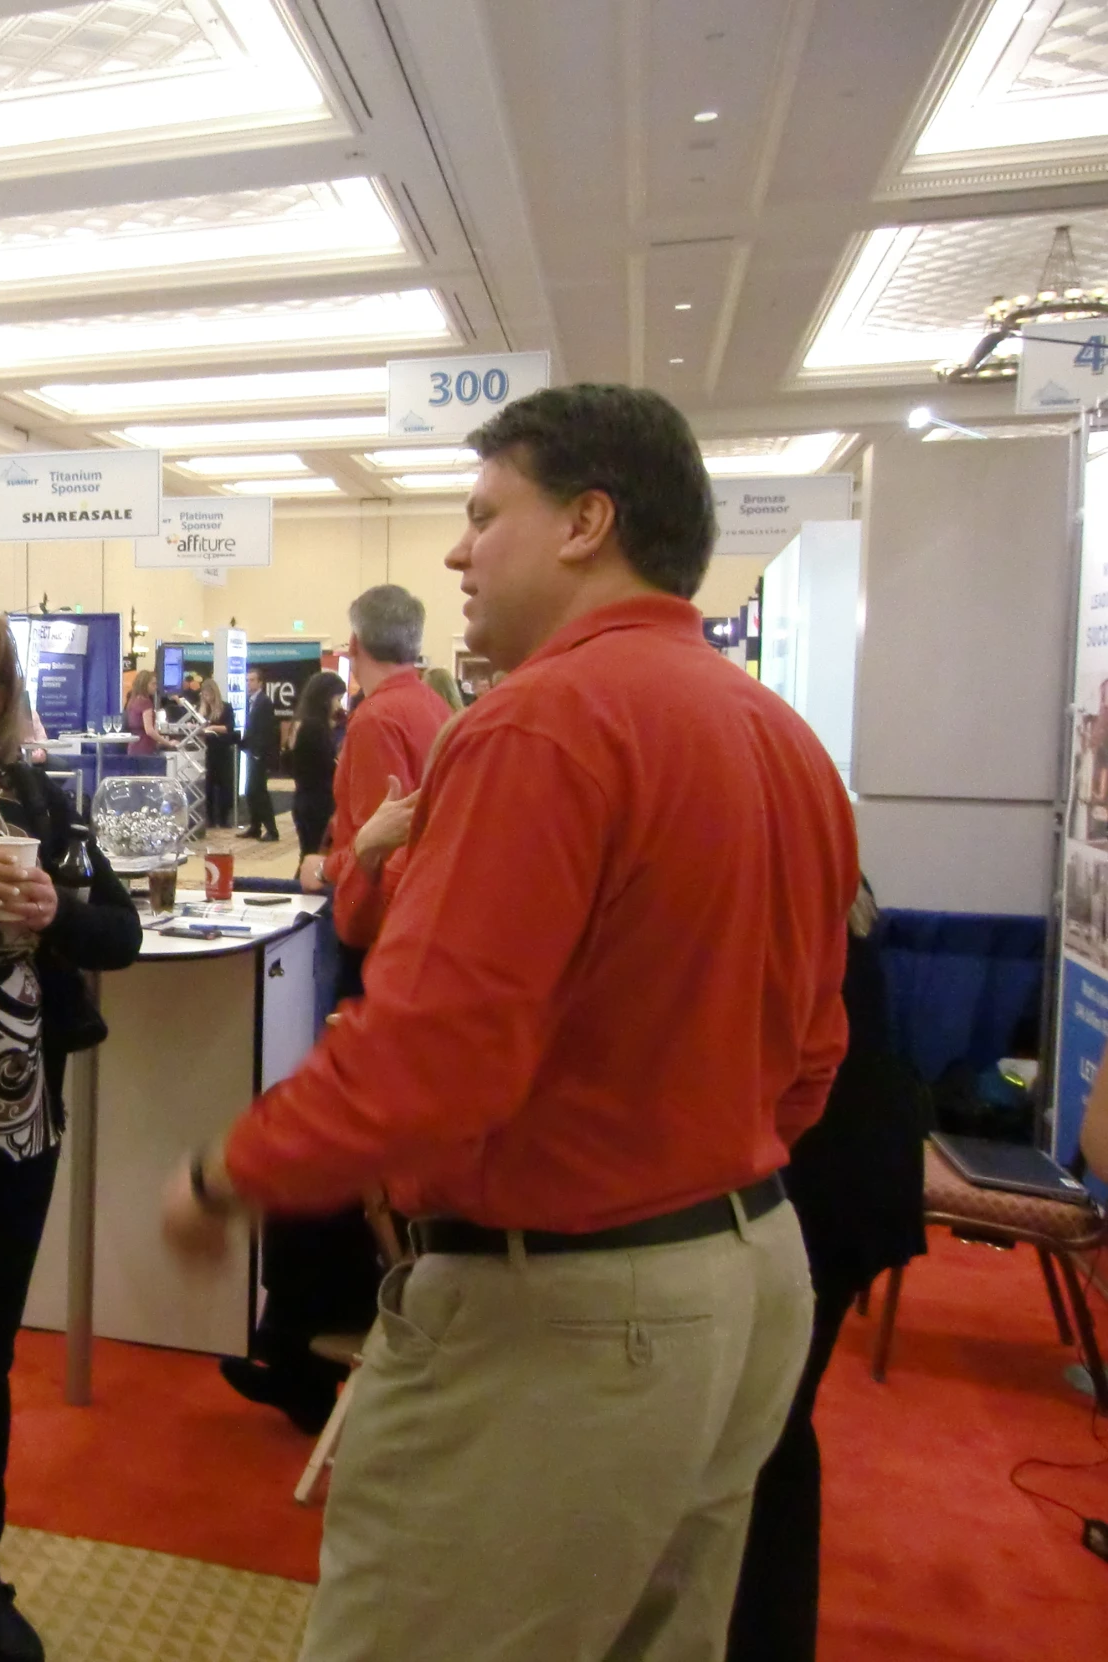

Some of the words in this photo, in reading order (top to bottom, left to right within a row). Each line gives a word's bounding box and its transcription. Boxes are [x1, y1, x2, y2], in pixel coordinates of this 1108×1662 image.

[428, 368, 510, 406] 300
[49, 469, 103, 482] Titanium
[51, 483, 101, 496] Sponsor
[743, 493, 787, 504] Bronze
[22, 508, 133, 524] SHAREASALE
[180, 511, 224, 521] Platinum
[739, 504, 791, 517] Sponsor
[181, 521, 223, 532] Sponsor
[176, 534, 237, 552] affiture
